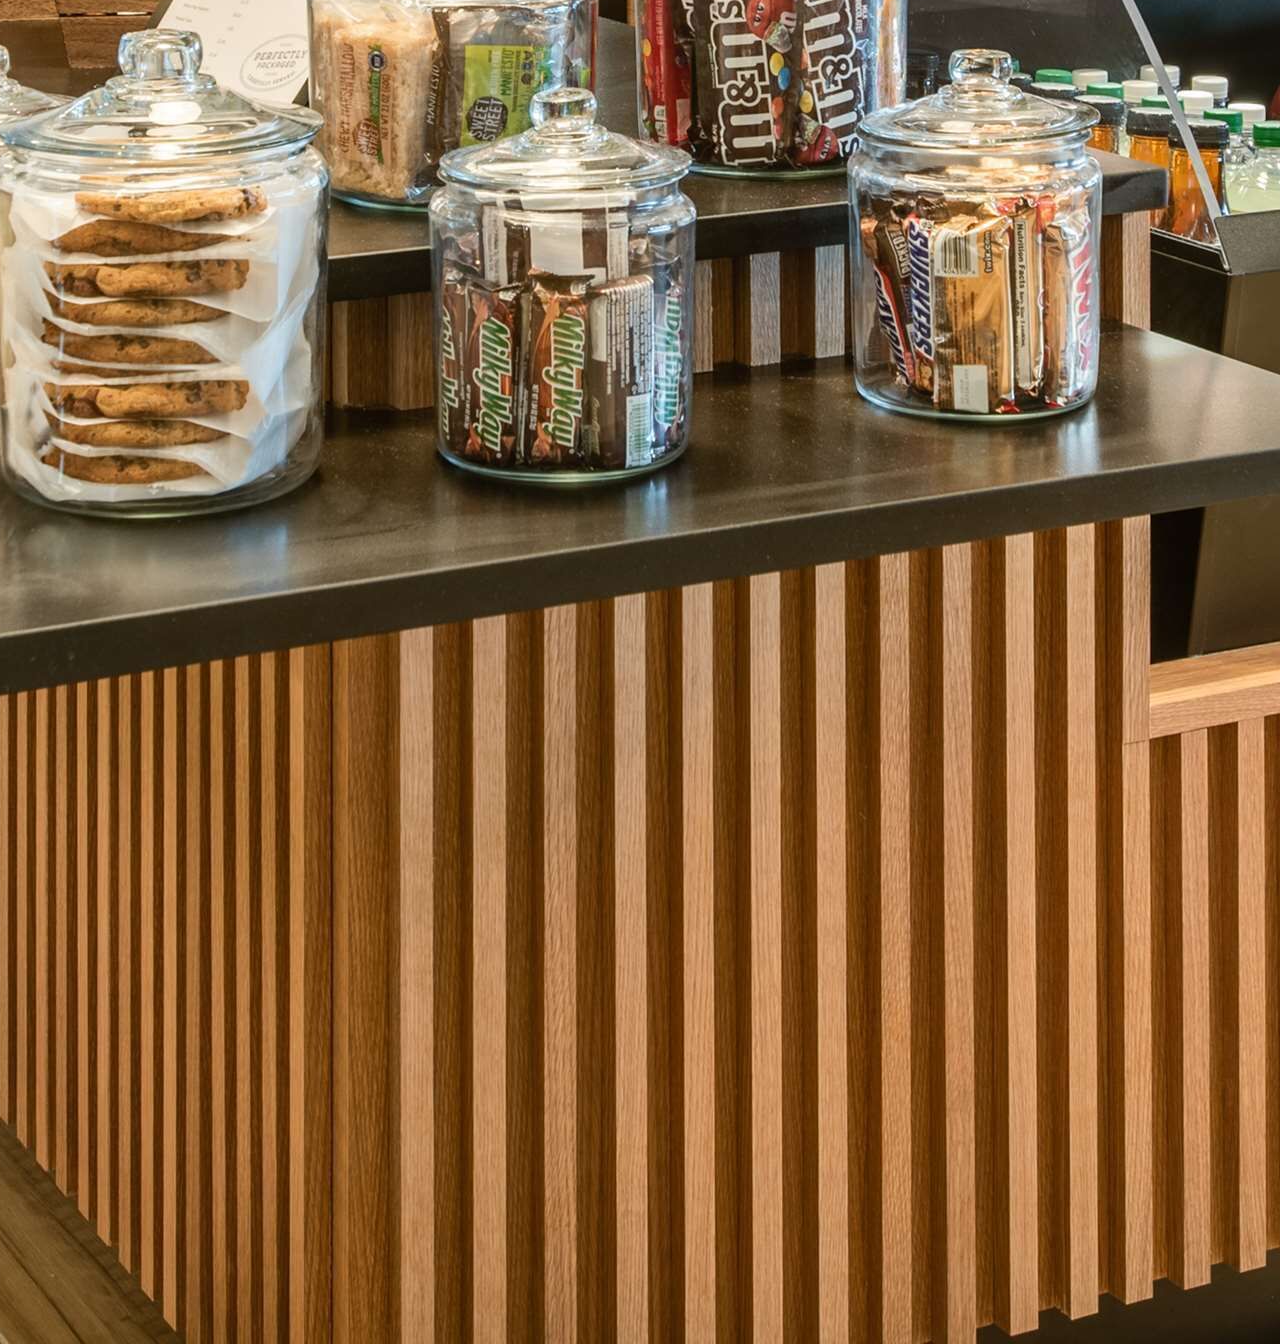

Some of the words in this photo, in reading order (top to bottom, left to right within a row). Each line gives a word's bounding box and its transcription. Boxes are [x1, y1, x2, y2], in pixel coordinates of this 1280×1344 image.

[254, 49, 308, 61] PERFECTLY
[500, 48, 514, 96] MANIFESTO
[471, 99, 489, 137] SWEET
[483, 98, 504, 141] STREET
[984, 231, 993, 273] twix.com
[1016, 223, 1024, 263] Nutrition
[908, 221, 934, 358] SNICKERS
[472, 316, 512, 391] Milky
[542, 312, 585, 390] Milky
[472, 386, 512, 452] Way
[542, 386, 583, 448] Way
